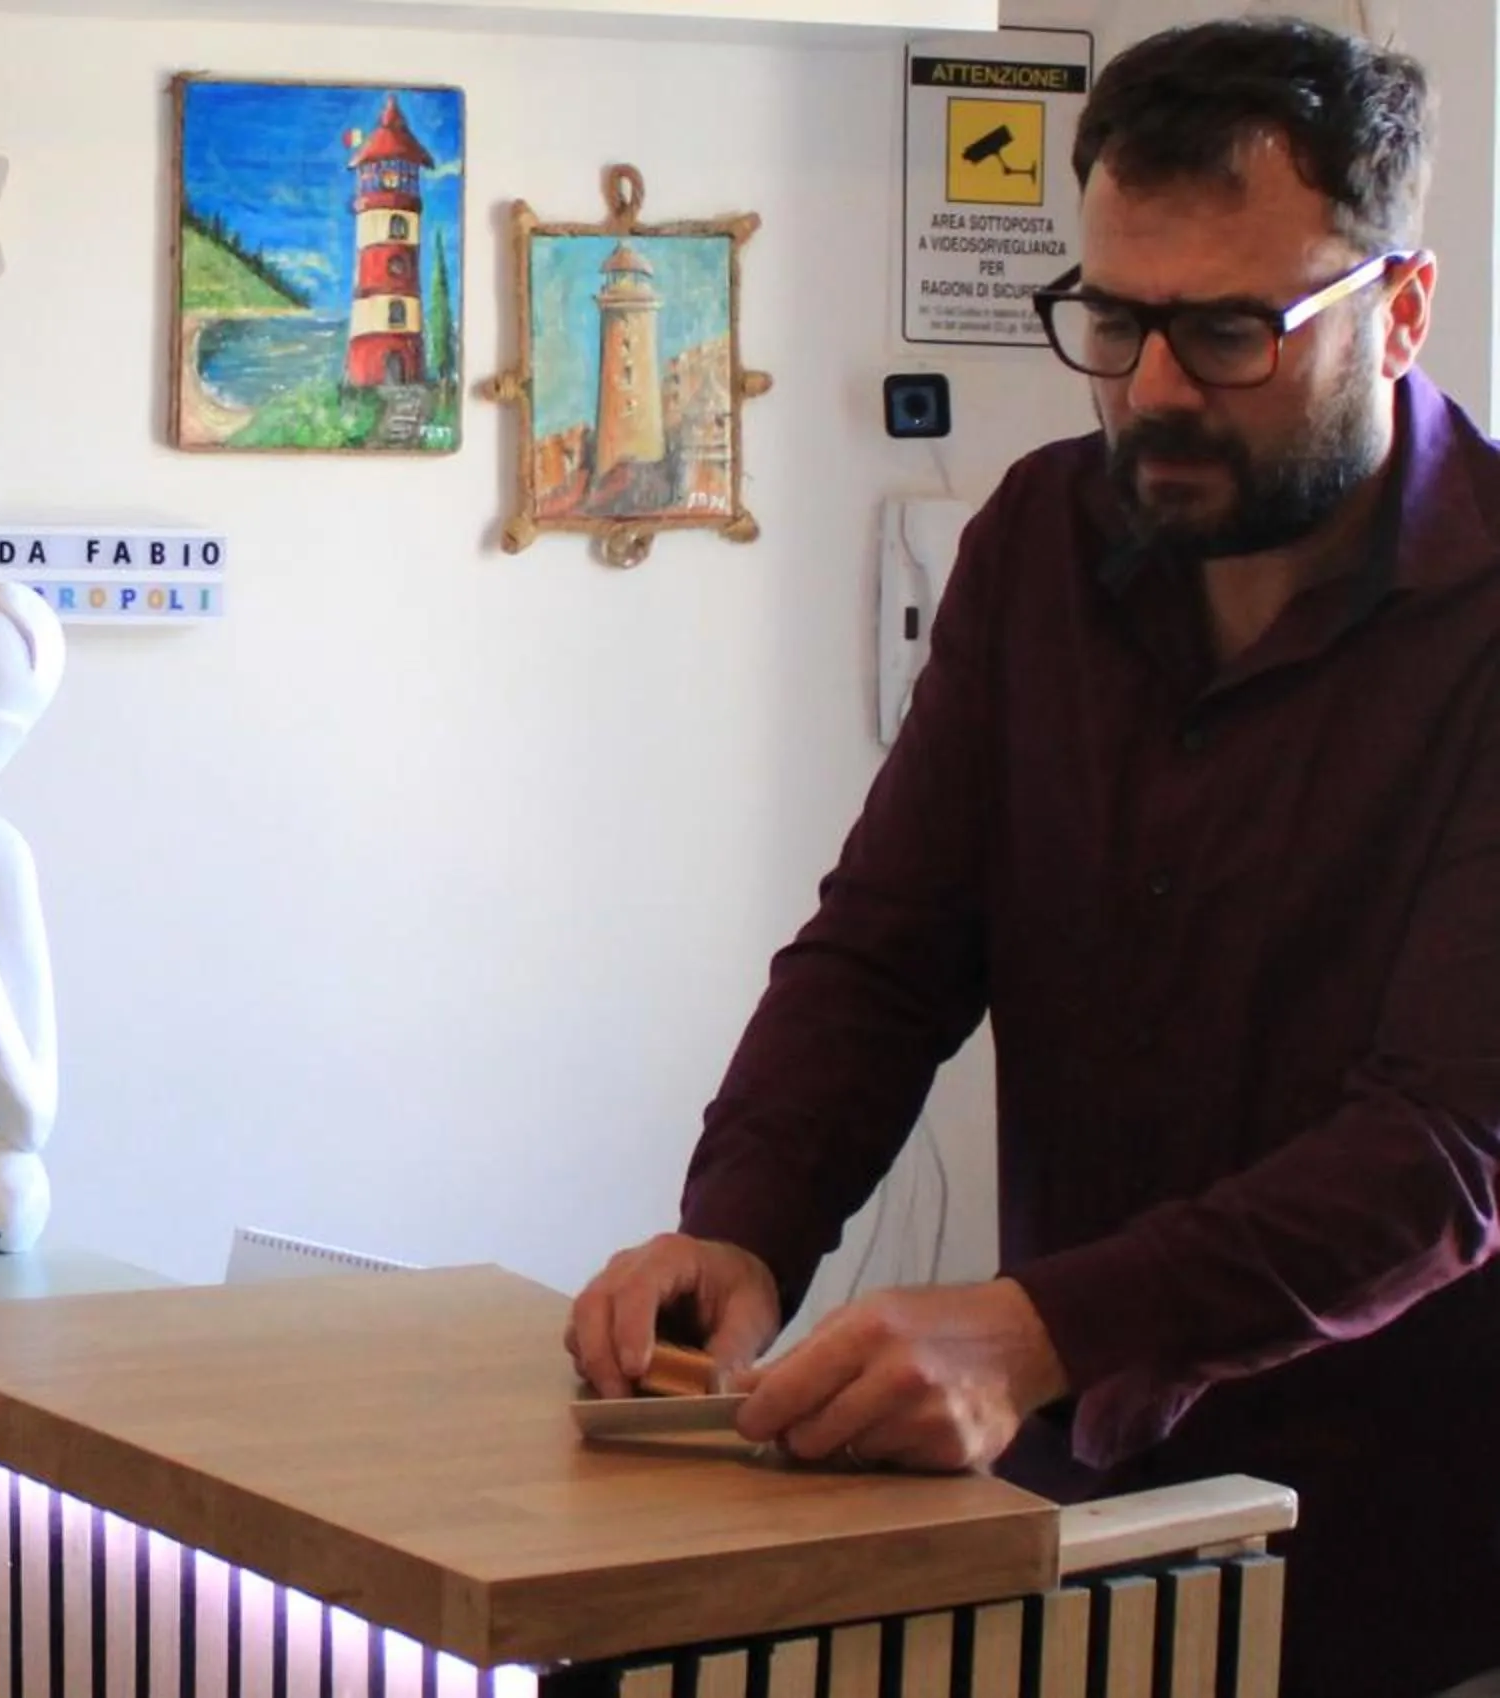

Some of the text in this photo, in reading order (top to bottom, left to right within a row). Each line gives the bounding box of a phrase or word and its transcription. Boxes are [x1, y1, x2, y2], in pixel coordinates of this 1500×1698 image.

[931, 62, 1069, 88] ATTENZIONE!
[931, 214, 1054, 233] AREA SOTTOPOSTA
[918, 235, 1066, 256] A VIDEOSORVEGLIANZA
[979, 260, 1005, 276] PER
[921, 280, 973, 297] RAGIONI
[977, 282, 989, 297] DI
[86, 540, 220, 567] FABIO
[32, 586, 210, 610] ROPOLI
